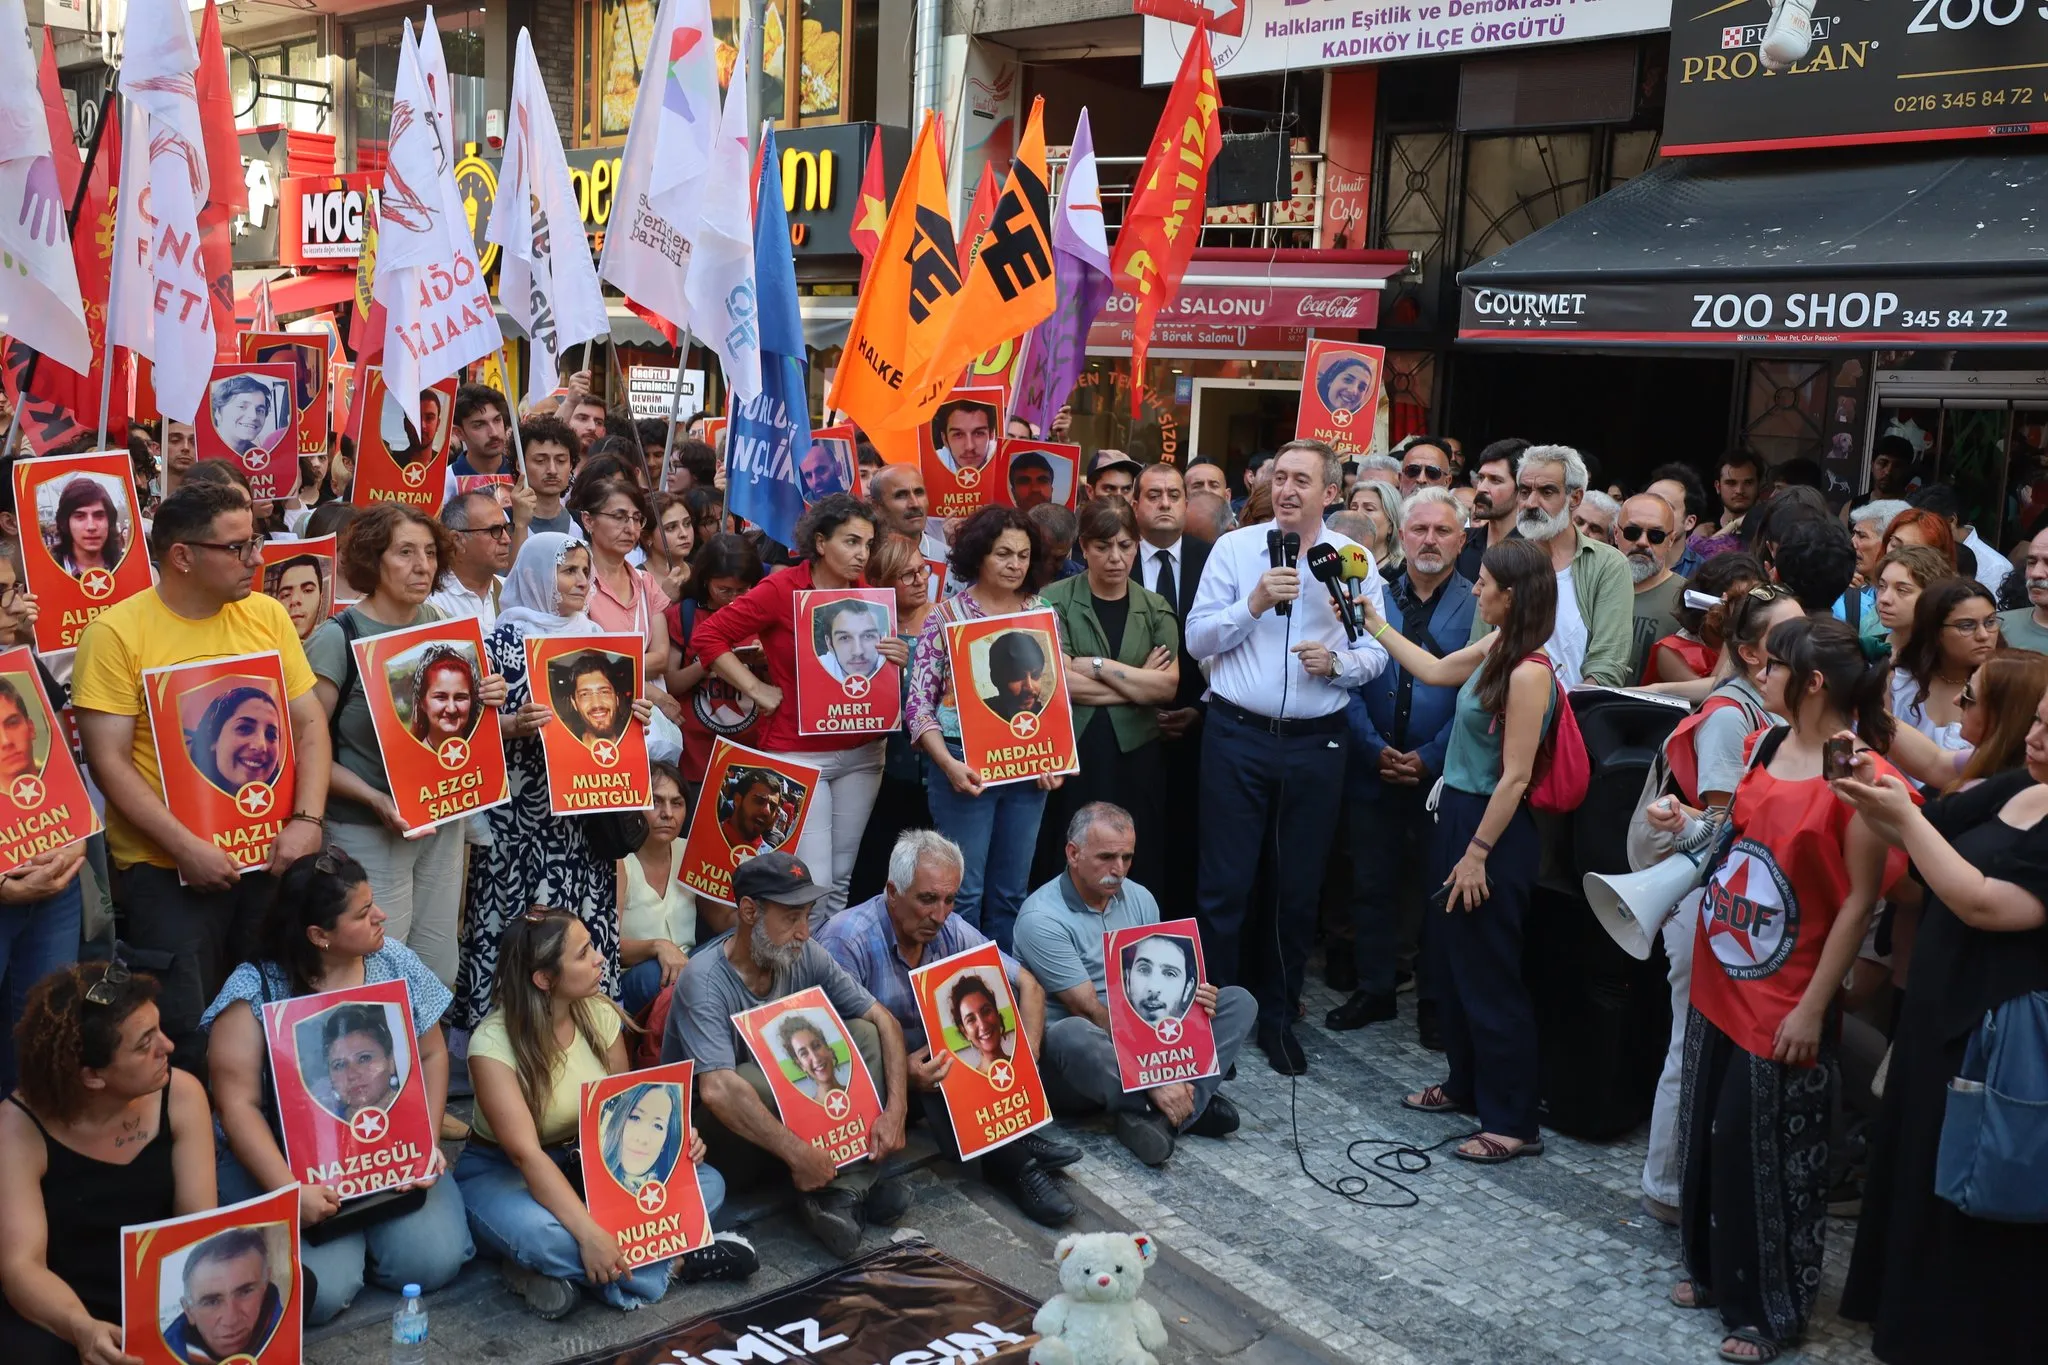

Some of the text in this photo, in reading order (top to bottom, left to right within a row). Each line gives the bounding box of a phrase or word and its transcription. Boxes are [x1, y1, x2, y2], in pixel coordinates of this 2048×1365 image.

[1264, 17, 1345, 38] Halkların
[1352, 6, 1412, 31] Eşitlik
[1418, 5, 1441, 20] ve
[1322, 14, 1566, 59] KADIKÖY İLÇE ÖRGÜTÜ
[1211, 45, 1235, 67] ARTİ
[1679, 52, 1758, 84] PRO
[1895, 95, 1936, 112] 0216
[1942, 91, 1976, 109] 345
[1981, 90, 2005, 106] 84
[2010, 88, 2033, 104] 72
[1996, 126, 2029, 134] PURINA
[1328, 175, 1366, 192] Umut
[1330, 198, 1363, 230] Cafe
[633, 208, 692, 255] yeniden
[629, 224, 682, 268] partisi
[1180, 297, 1265, 316] SALONU
[1474, 289, 1587, 318] GOURMET
[1691, 292, 2008, 328] ZOO SHOP 345 84 72
[1162, 330, 1193, 342] Börek
[1197, 330, 1234, 343] Salonu
[632, 394, 662, 403] DEVRİM
[1158, 412, 1178, 467] SİZDE
[1314, 428, 1353, 441] NAZLI
[369, 488, 433, 504] NARTAN
[943, 492, 982, 505] MERT
[1327, 552, 1337, 561] TV
[816, 714, 885, 732] CÖMERT
[827, 702, 872, 717] MERT
[986, 737, 1054, 764] MEDALİ
[572, 772, 632, 790] MURAT
[980, 755, 1065, 781] BARUTÇU
[419, 766, 484, 804] A.EZGİ
[562, 787, 644, 809] YURTGÜL
[428, 791, 481, 821] ŞALCI
[0, 803, 71, 847] ALİCAN
[212, 819, 286, 848] NAZLI
[4, 828, 76, 866] VURAL
[685, 870, 730, 898] EMRE
[1704, 875, 1779, 938] SGDF
[1136, 1046, 1194, 1068] VATAN
[1138, 1061, 1200, 1085] BUDAK
[975, 1085, 1031, 1126] H.EZGİ
[811, 1114, 866, 1150] H.EZGİ
[984, 1108, 1033, 1143] SADET
[306, 1140, 422, 1184] NAZEGÜL
[829, 1135, 868, 1163] ADET
[328, 1164, 416, 1197] OYRAZ
[617, 1212, 681, 1247] NURAY
